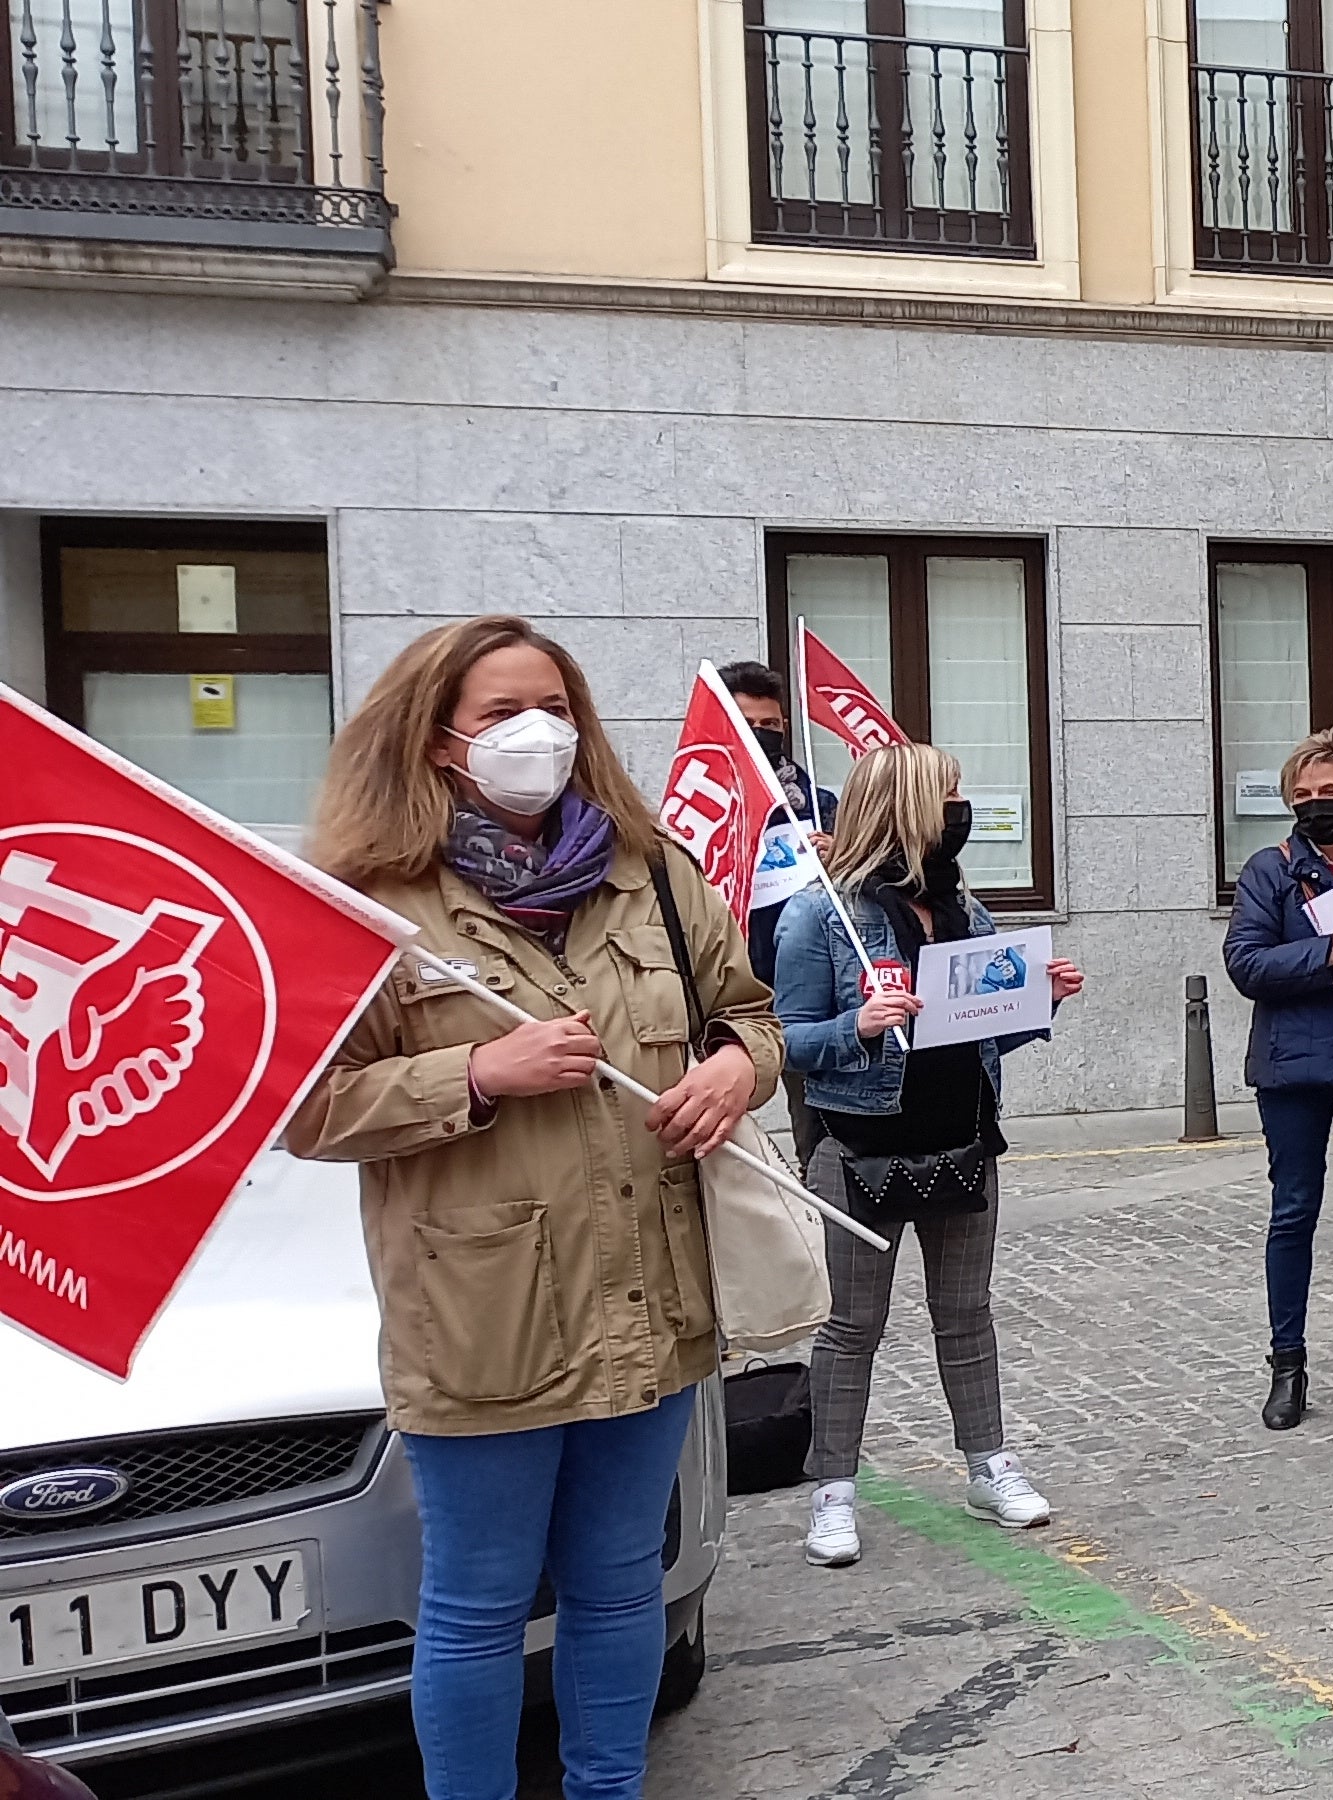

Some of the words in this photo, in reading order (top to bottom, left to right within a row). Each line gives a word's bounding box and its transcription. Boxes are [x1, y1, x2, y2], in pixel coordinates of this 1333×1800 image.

[954, 1005, 999, 1020] VACUNAS
[1002, 1002, 1015, 1013] YA
[25, 1479, 97, 1508] Ford
[142, 1560, 293, 1644] DYY
